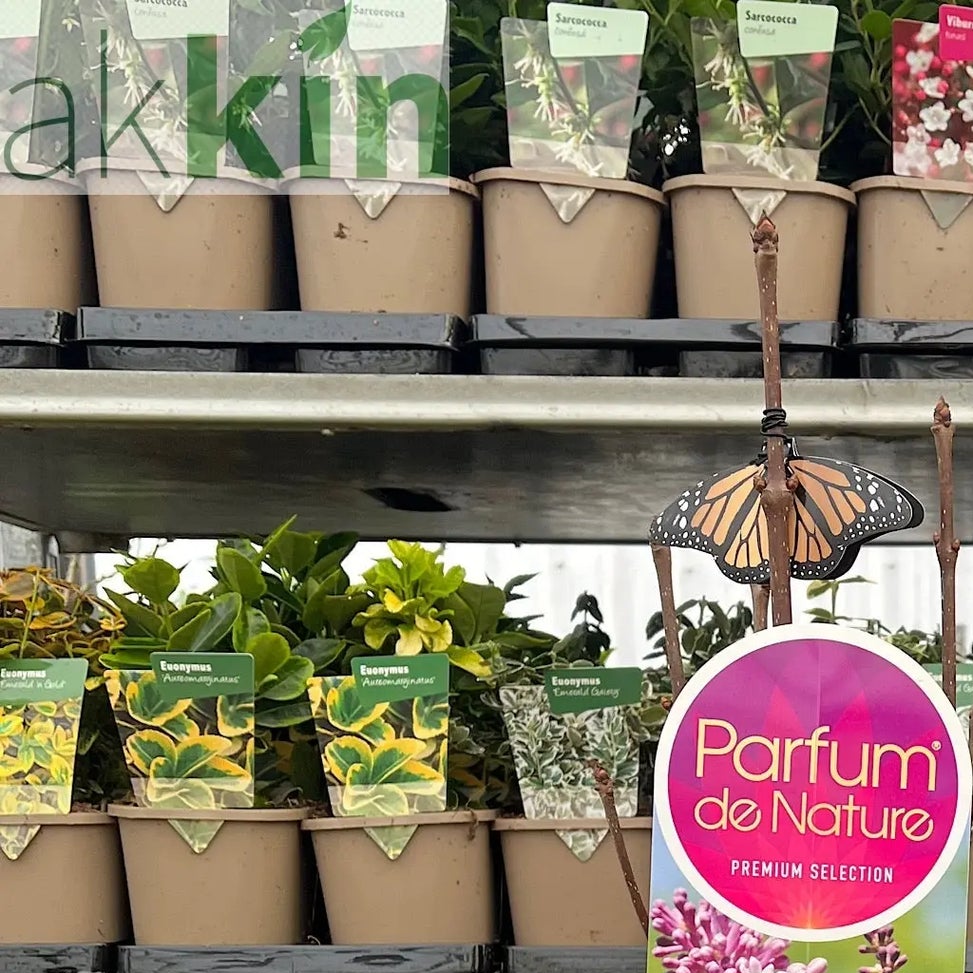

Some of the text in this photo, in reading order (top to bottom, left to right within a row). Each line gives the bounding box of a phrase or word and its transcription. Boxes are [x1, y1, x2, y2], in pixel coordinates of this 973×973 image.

[353, 5, 405, 18] Sarcococca
[745, 10, 797, 25] Sarcococca
[556, 13, 607, 28] Sarcococca
[160, 660, 212, 673] Euonymus
[360, 664, 409, 677] Euonymus
[0, 668, 47, 681] Euonymus
[551, 676, 601, 688] Euonymus
[694, 787, 934, 842] de Nature
[731, 859, 894, 883] PREMIUM SELECTION
